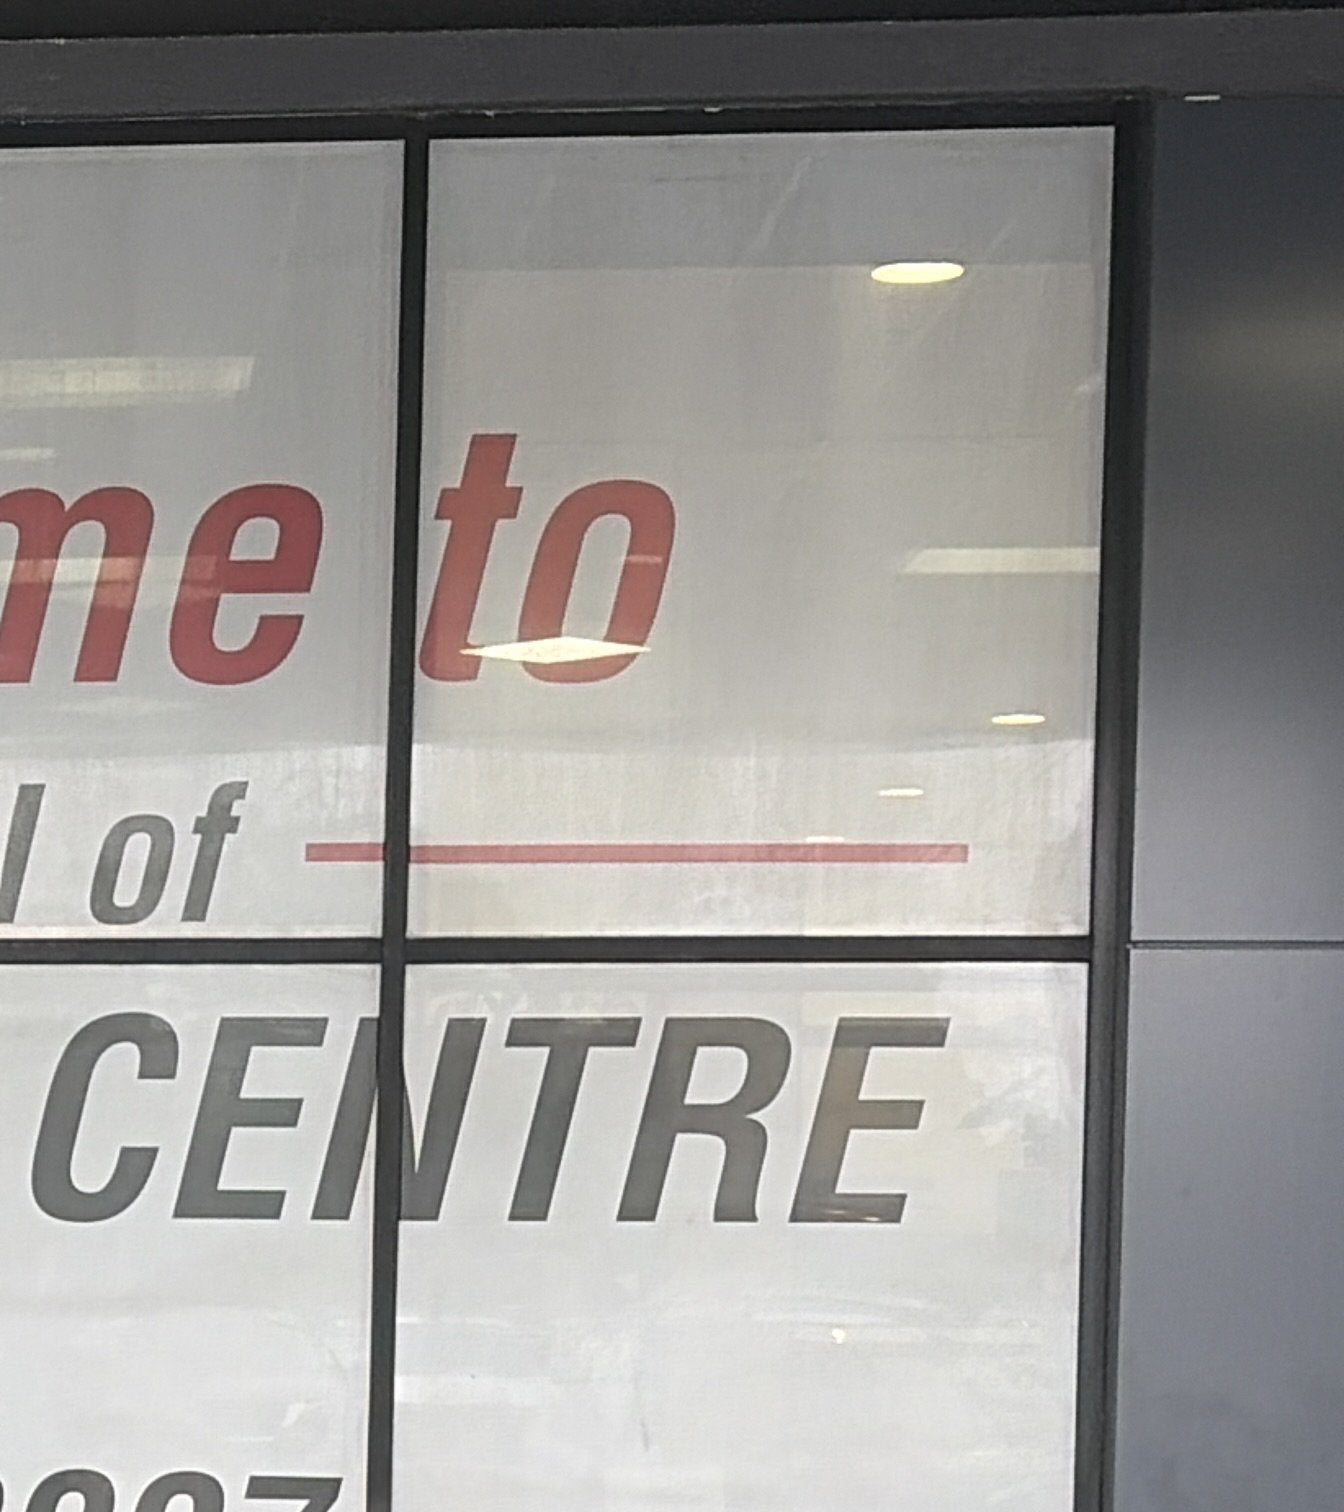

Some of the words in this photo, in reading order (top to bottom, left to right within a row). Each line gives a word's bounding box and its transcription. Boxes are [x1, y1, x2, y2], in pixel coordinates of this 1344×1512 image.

[419, 432, 676, 683] to
[90, 780, 248, 923] of
[23, 1015, 950, 1223] CENTRE
